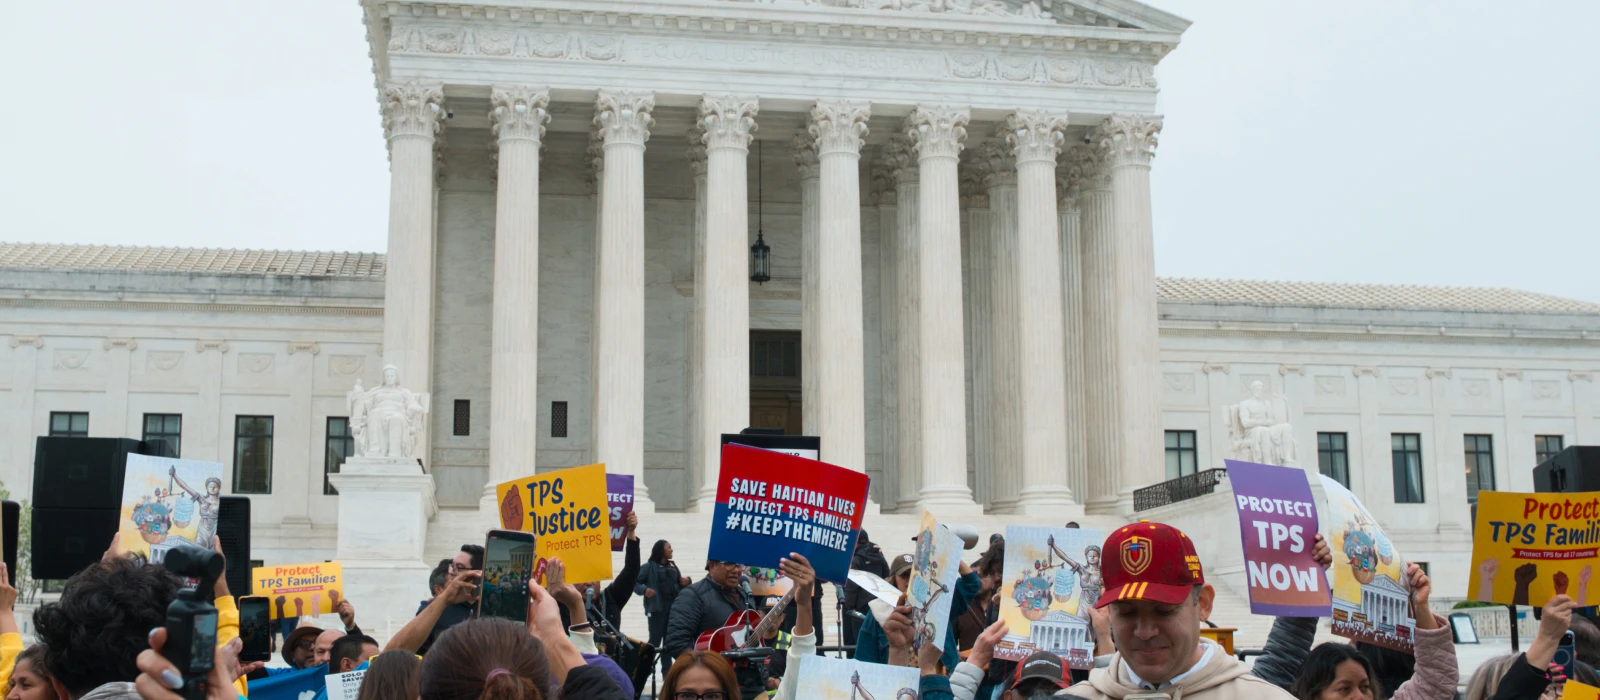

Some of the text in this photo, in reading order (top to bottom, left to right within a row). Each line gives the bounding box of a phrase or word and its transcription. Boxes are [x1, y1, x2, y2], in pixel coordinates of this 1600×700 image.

[640, 42, 928, 69] EQUAL JUSTICE UNDER LAW
[526, 478, 563, 508] TPS
[606, 493, 632, 503] TECT
[731, 478, 856, 517] SAVE HAITIAN LIVES
[1236, 494, 1313, 518] PROTECT
[528, 502, 602, 536] Justice
[728, 496, 852, 533] PROTECT TPS FAMILIES
[1523, 498, 1600, 520] Protect
[546, 534, 603, 551] Protect TPS
[726, 512, 849, 552] #KEEPTHEMHERE
[1252, 520, 1305, 553] TPS
[1489, 519, 1600, 546] TPS Famili
[1519, 550, 1541, 558] Protect
[260, 574, 336, 589] TPS Families
[275, 565, 320, 577] Protect
[1248, 560, 1319, 592] NOW
